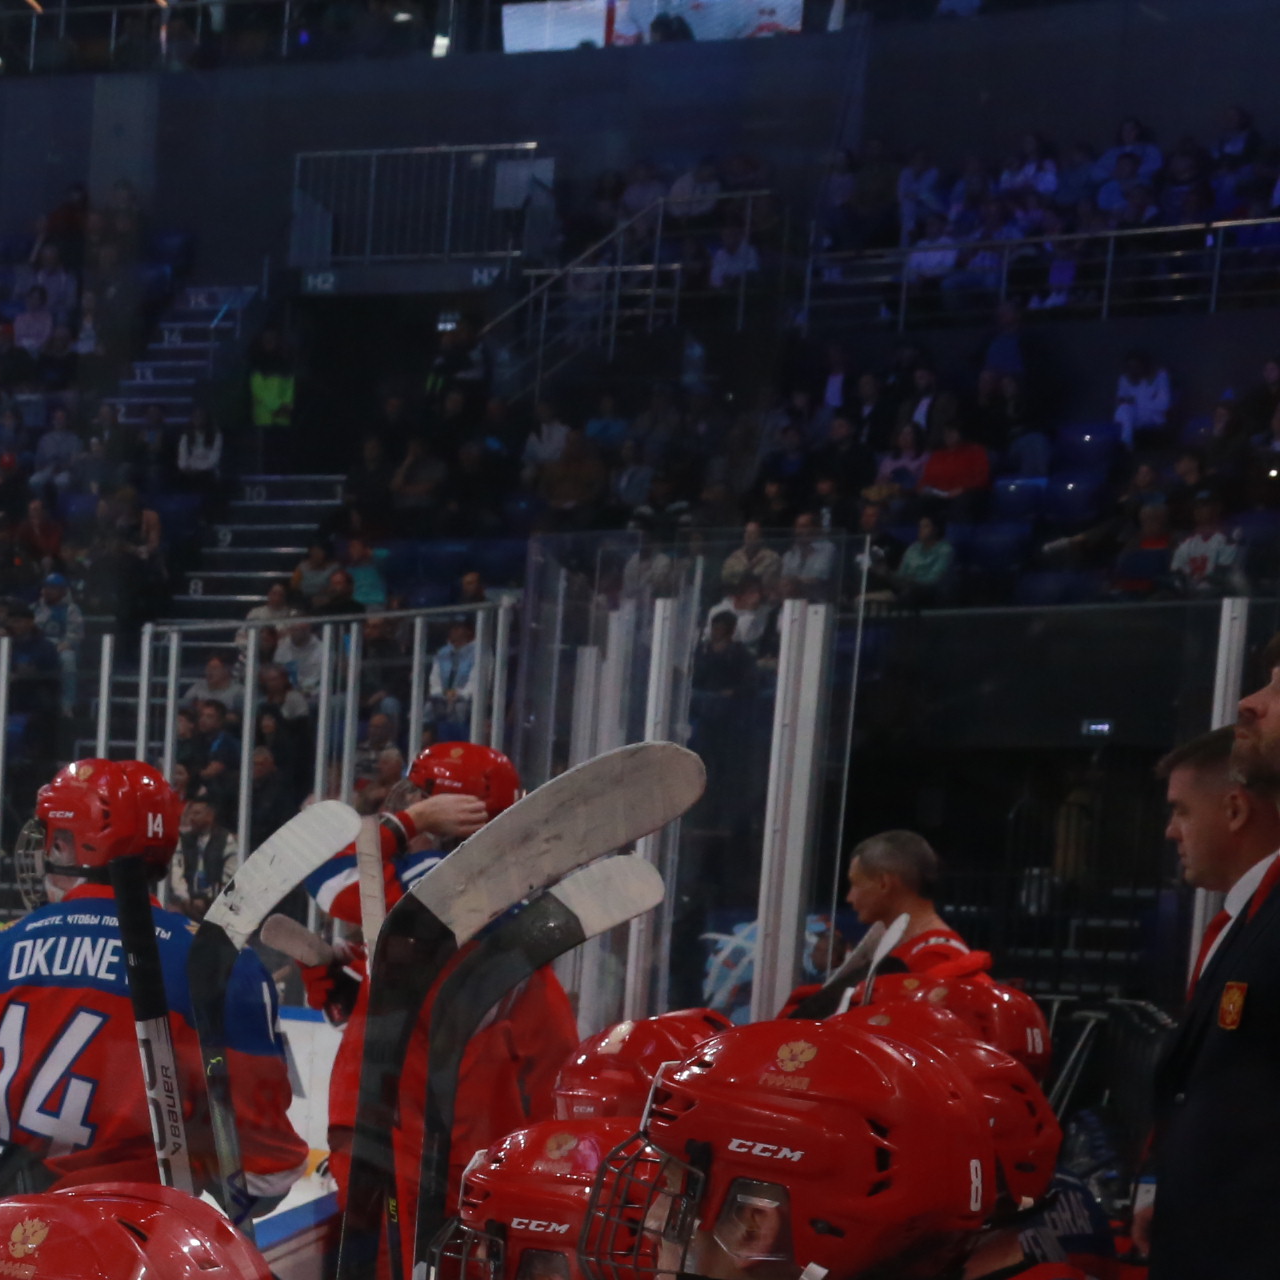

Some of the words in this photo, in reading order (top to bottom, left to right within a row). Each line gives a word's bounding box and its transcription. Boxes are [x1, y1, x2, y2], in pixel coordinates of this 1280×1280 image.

[217, 530, 233, 547] 9
[189, 578, 203, 596] 8
[48, 811, 75, 819] CCM
[147, 812, 164, 839] 14
[8, 936, 129, 985] OKUNE
[728, 1138, 806, 1163] CCM
[969, 1158, 983, 1212] 8
[510, 1217, 570, 1235] CCM
